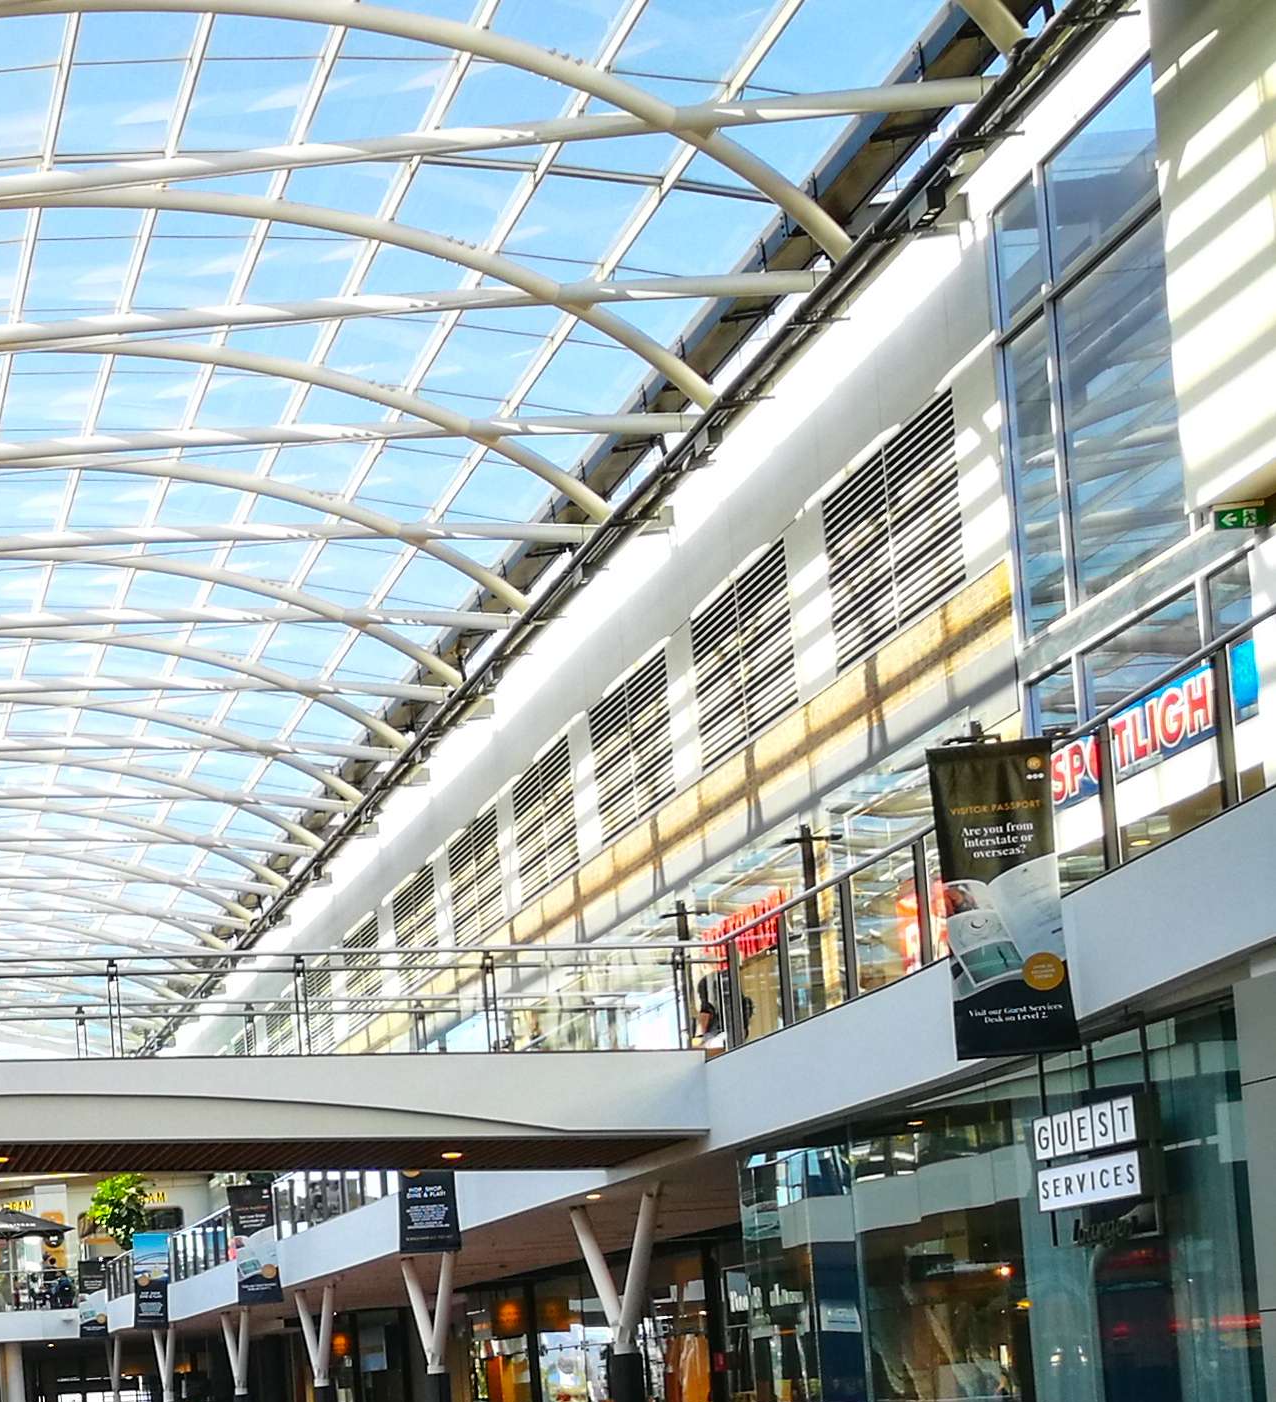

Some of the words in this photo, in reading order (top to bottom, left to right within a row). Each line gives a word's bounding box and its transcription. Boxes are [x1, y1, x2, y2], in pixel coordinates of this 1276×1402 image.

[1050, 673, 1216, 805] SPOTLIGH
[949, 805, 989, 817] VISITOR
[990, 799, 1041, 813] PASSPORT
[960, 825, 982, 838] Are
[983, 824, 1003, 837] you
[1005, 821, 1034, 833] from
[964, 835, 1018, 849] interstate
[1021, 833, 1034, 843] or
[973, 844, 1027, 859] overseas?
[1037, 1106, 1129, 1150] GUEST
[1041, 1164, 1135, 1200] SERVICES
